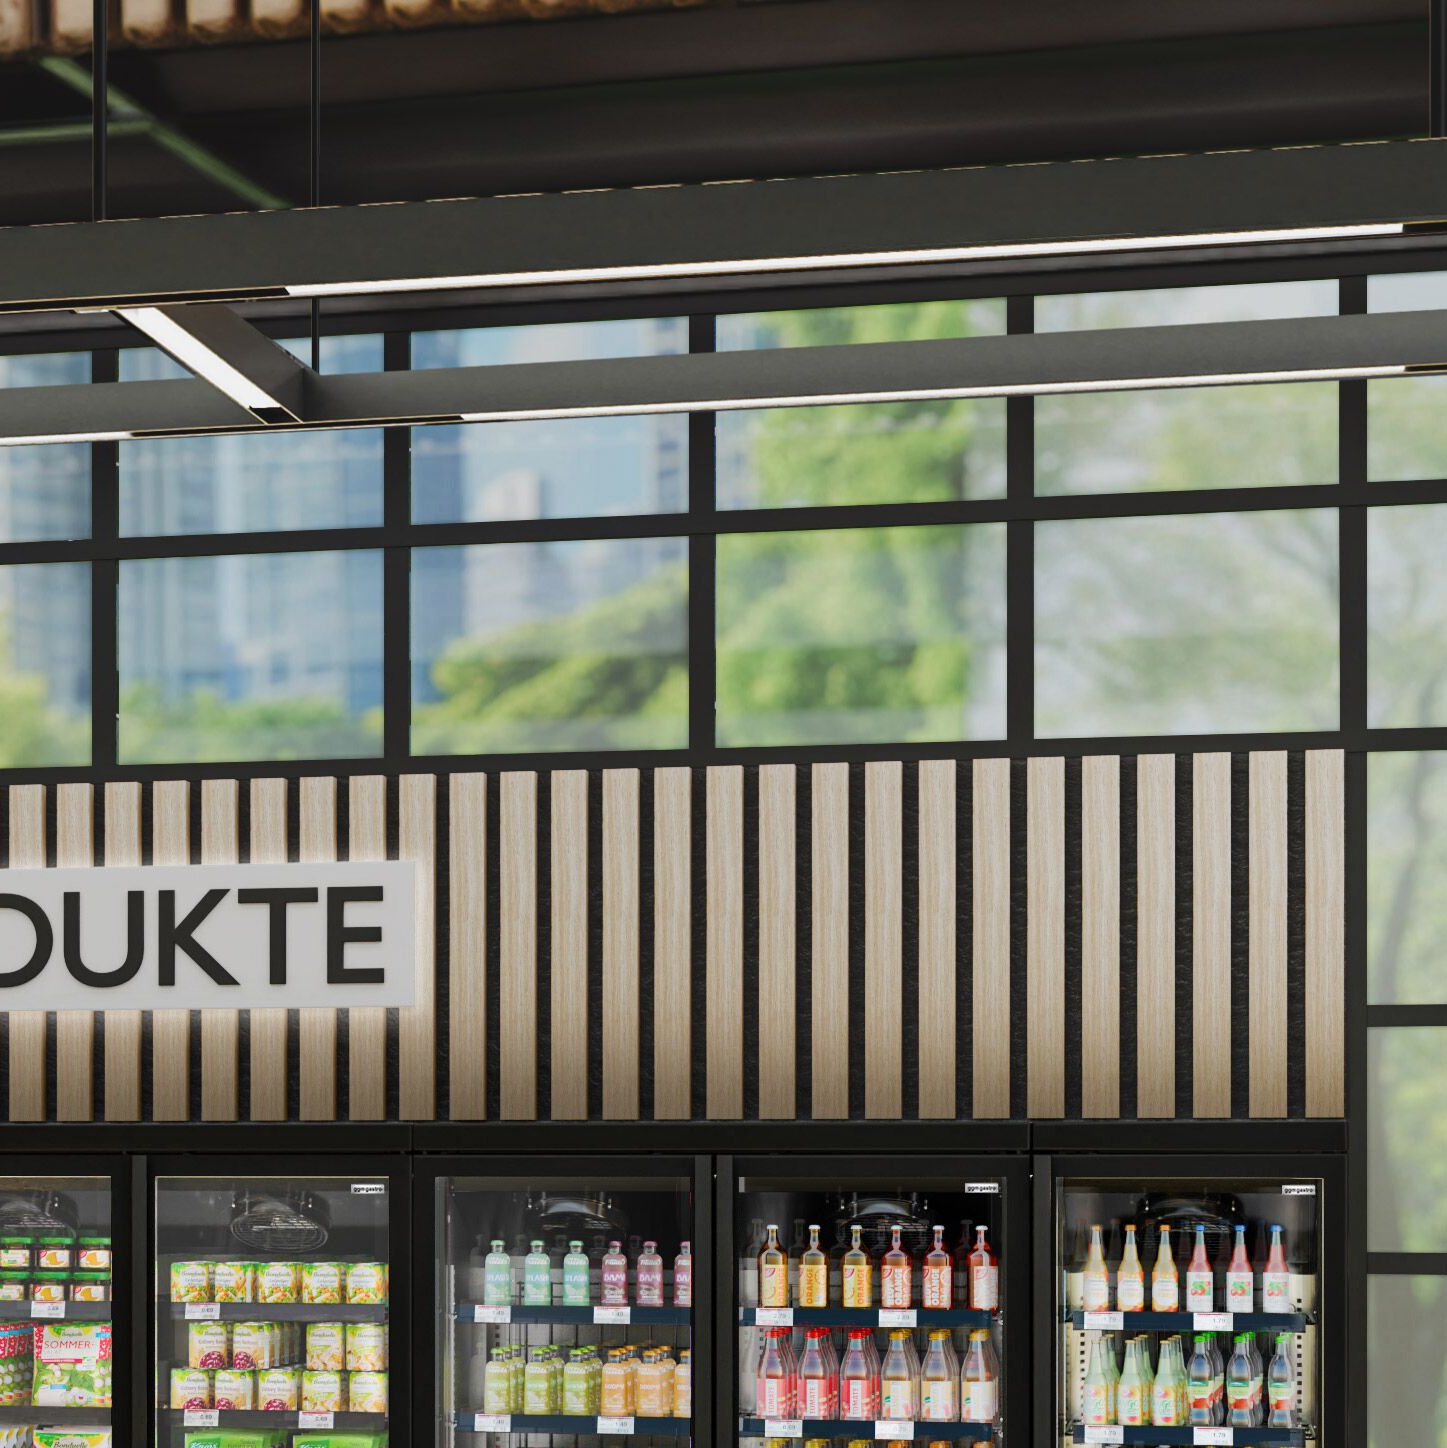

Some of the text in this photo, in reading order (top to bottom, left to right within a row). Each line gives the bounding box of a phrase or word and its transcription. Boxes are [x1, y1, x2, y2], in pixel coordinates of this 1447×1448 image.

[805, 1267, 814, 1305] ORANGE
[856, 1267, 865, 1305] ORANGE
[930, 1268, 940, 1306] ORANGE
[44, 1340, 95, 1350] SOMMER-
[809, 1386, 817, 1417] TOMATE
[851, 1386, 859, 1417] TOMATE
